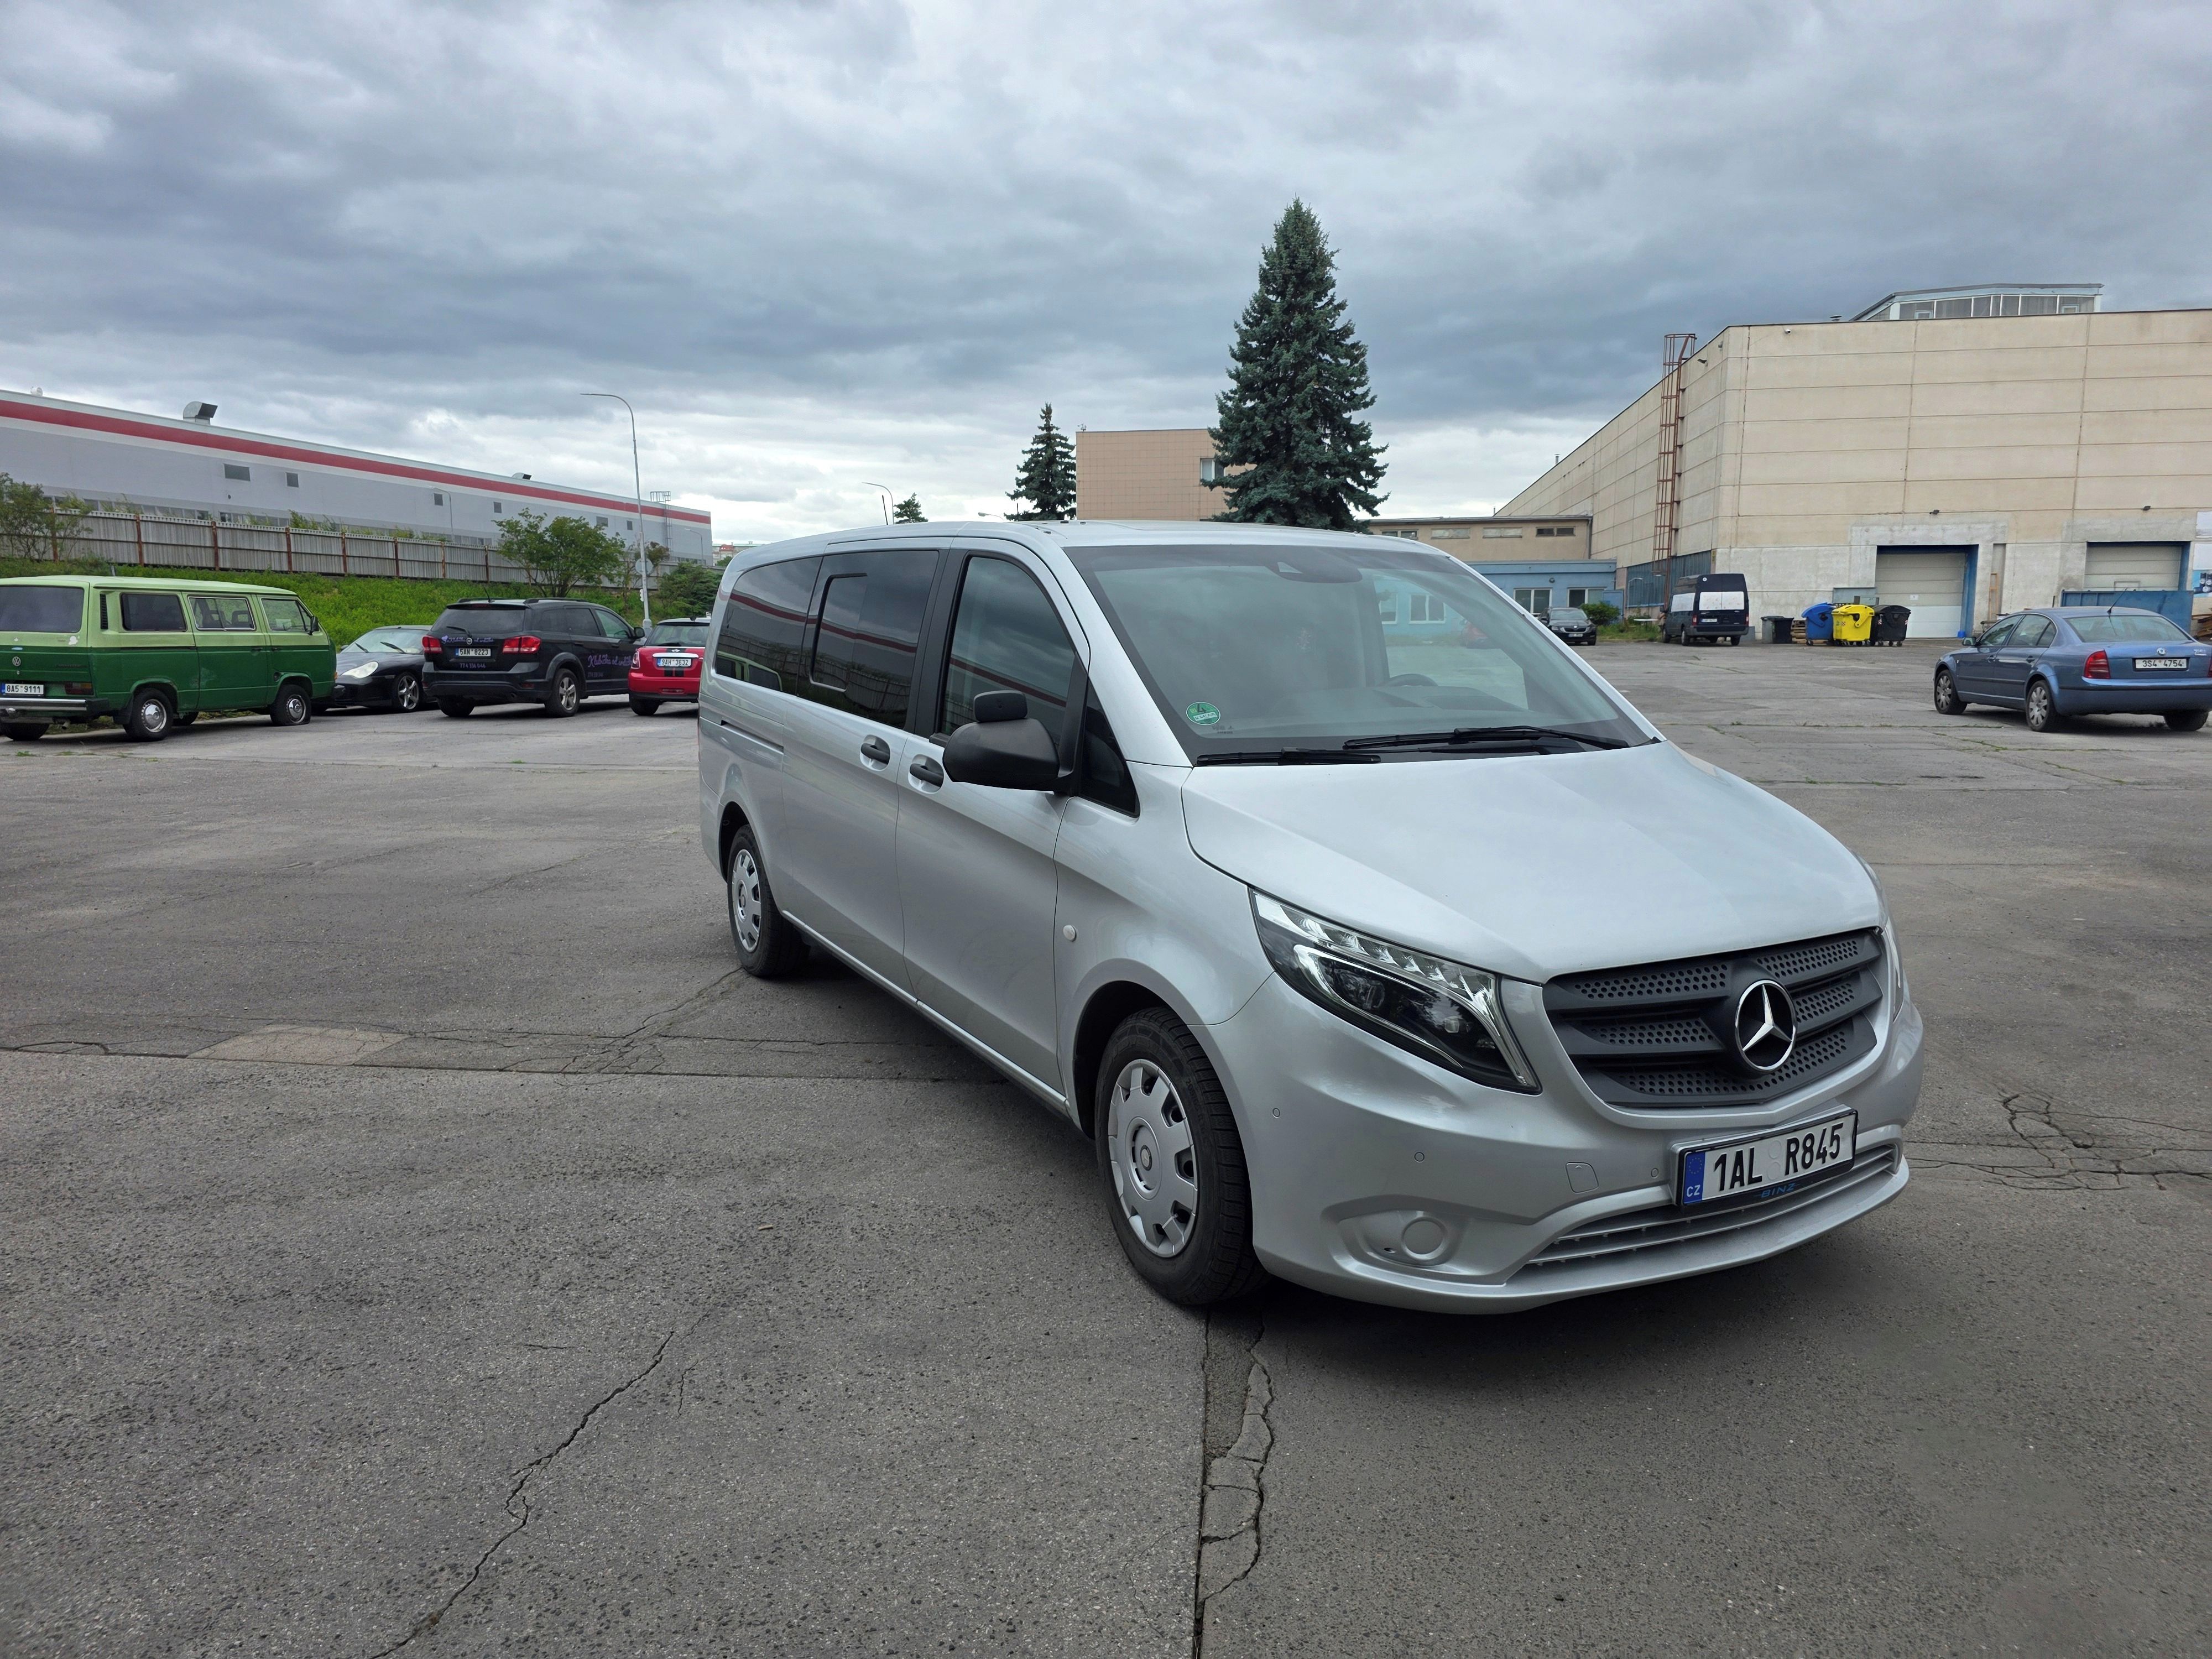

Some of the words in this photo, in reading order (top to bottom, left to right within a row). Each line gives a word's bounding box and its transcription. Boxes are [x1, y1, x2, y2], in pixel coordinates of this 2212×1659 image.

[1714, 1147, 1762, 1191] 1AL
[1785, 1123, 1844, 1176] R845
[1687, 1185, 1700, 1197] CZ
[1761, 1183, 1796, 1198] BINZ
